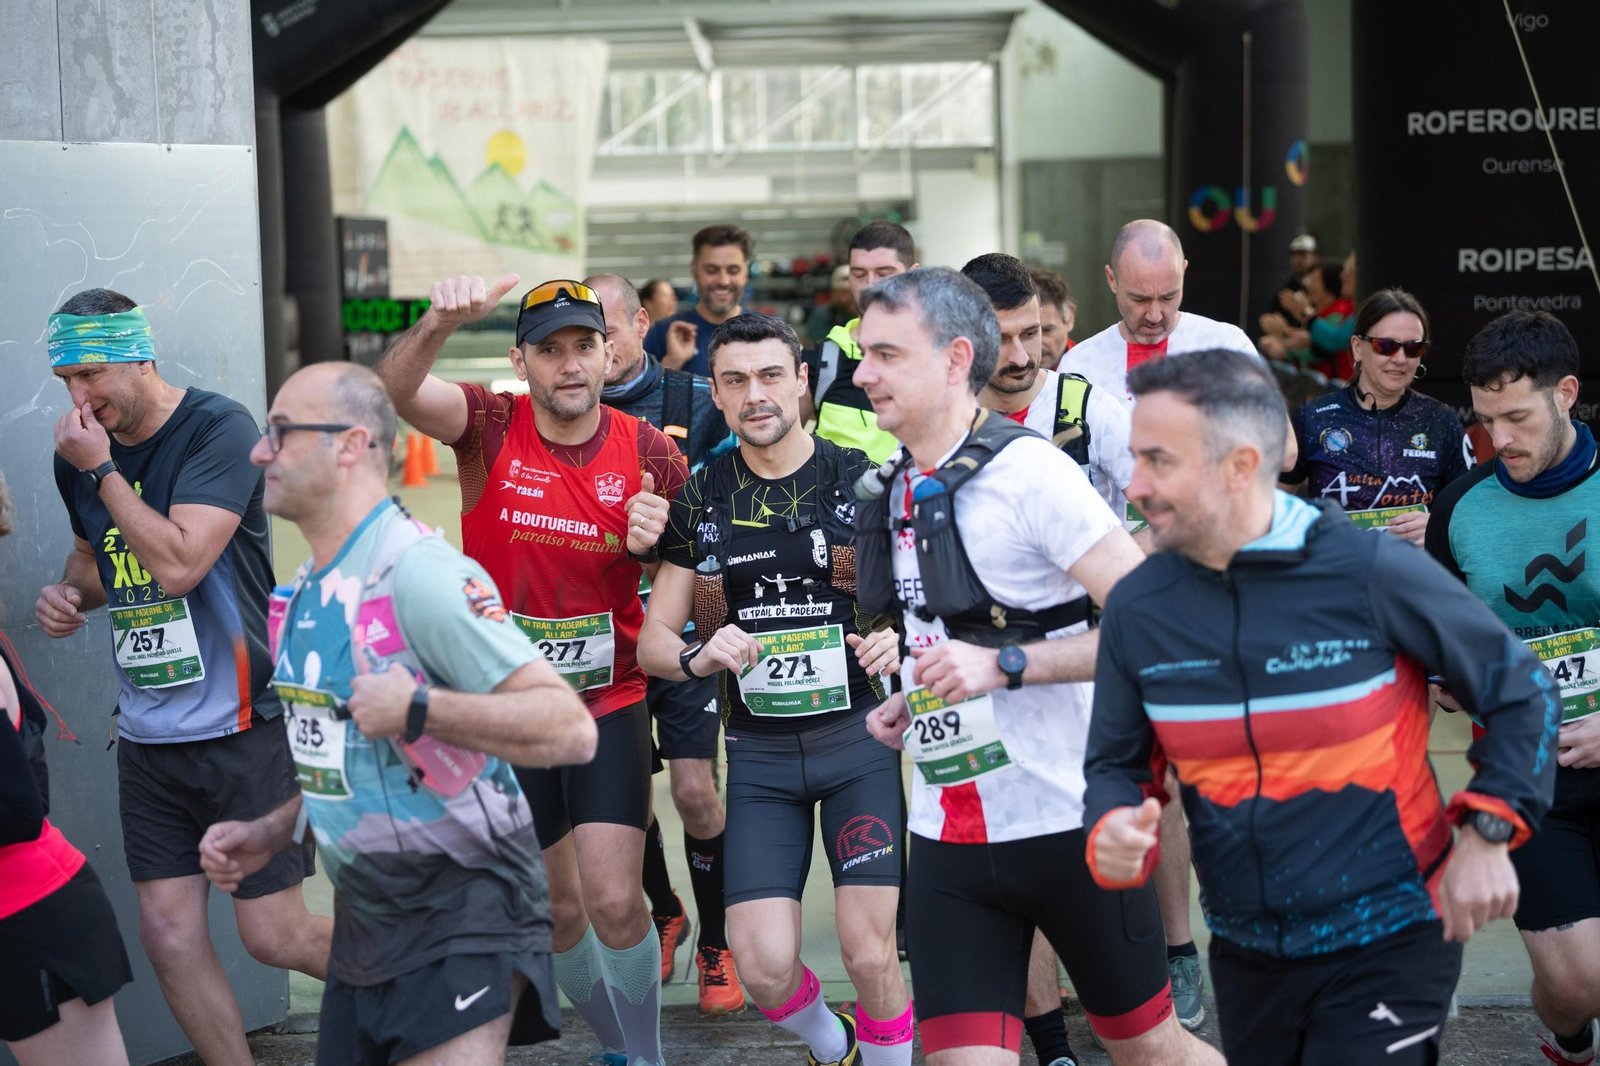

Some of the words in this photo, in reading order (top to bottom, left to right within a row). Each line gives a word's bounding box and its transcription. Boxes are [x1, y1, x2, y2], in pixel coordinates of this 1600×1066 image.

[1504, 13, 1549, 32] Vigo
[1407, 107, 1600, 136] ROFEROURE
[1482, 156, 1565, 175] Ourense
[1458, 246, 1596, 273] ROIPESA
[1474, 293, 1582, 312] Pontevedra
[1403, 448, 1437, 460] FEDME
[516, 485, 544, 499] rasán
[499, 507, 509, 521] A
[511, 510, 598, 537] BOUTUREIRA
[509, 528, 565, 547] paraíso
[570, 537, 625, 554] natural
[702, 532, 721, 543] MAX
[135, 605, 163, 617] PADERNE
[163, 603, 174, 612] DE
[750, 607, 773, 618] TRAIL
[775, 606, 786, 616] DE
[789, 605, 829, 616] PADERNE
[131, 616, 154, 628] ALLARIZ
[532, 621, 554, 630] TRAIL
[555, 618, 589, 630] PADERNE
[590, 617, 600, 626] DE
[130, 627, 165, 653] 257
[544, 630, 578, 639] ALLARIZ
[757, 636, 780, 647] TRAIL
[781, 631, 817, 644] PADERNE
[817, 629, 829, 639] DE
[1546, 633, 1583, 649] PADERNE
[1583, 630, 1596, 640] DE
[538, 639, 587, 662] 277
[770, 643, 805, 654] ALLARIZ
[1538, 645, 1574, 660] ALLARIZ
[766, 654, 816, 680] 271
[1553, 656, 1586, 682] 47
[294, 716, 325, 748] 35
[914, 710, 961, 745] 289
[842, 844, 894, 872] KINETIK
